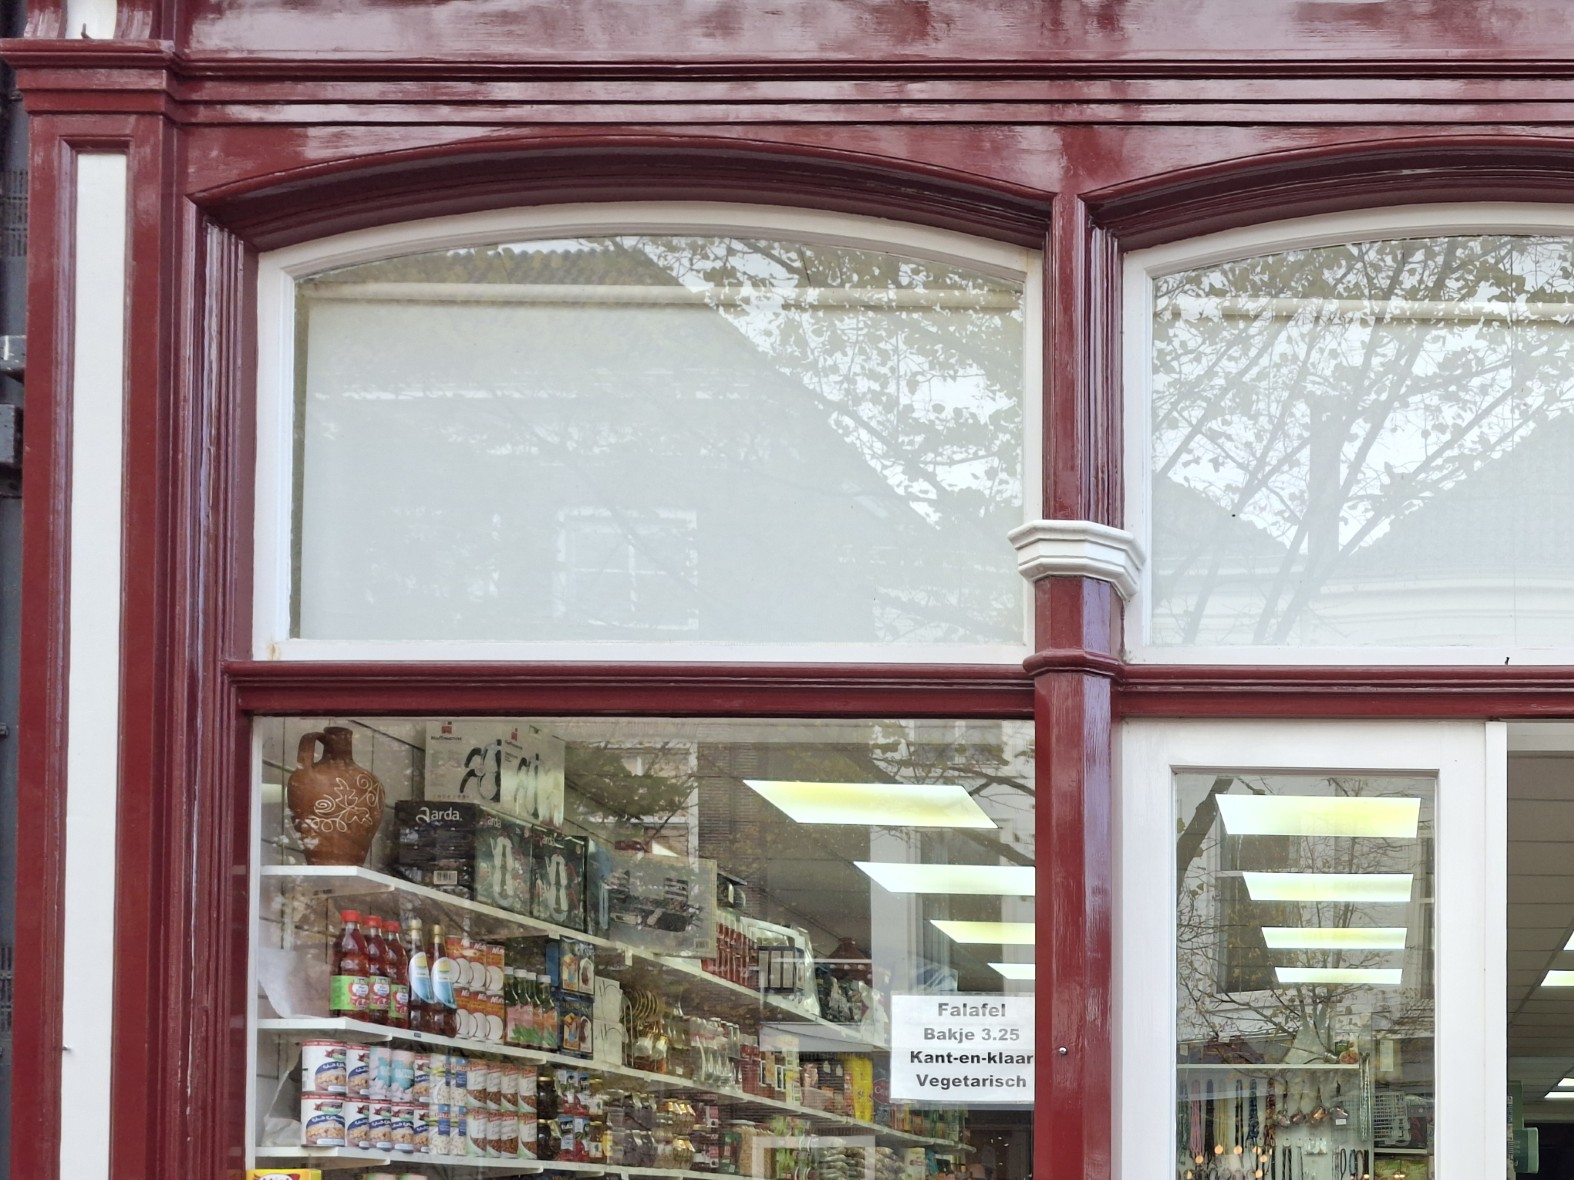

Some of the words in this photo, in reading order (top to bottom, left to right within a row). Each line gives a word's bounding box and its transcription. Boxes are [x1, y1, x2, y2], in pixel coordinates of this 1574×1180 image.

[938, 1002, 1006, 1017] Falafel
[923, 1027, 976, 1044] Bakje
[981, 1028, 1020, 1042] 3.25
[910, 1051, 1034, 1065] Kant-en-klaar
[916, 1074, 1027, 1091] Vegetarisch
